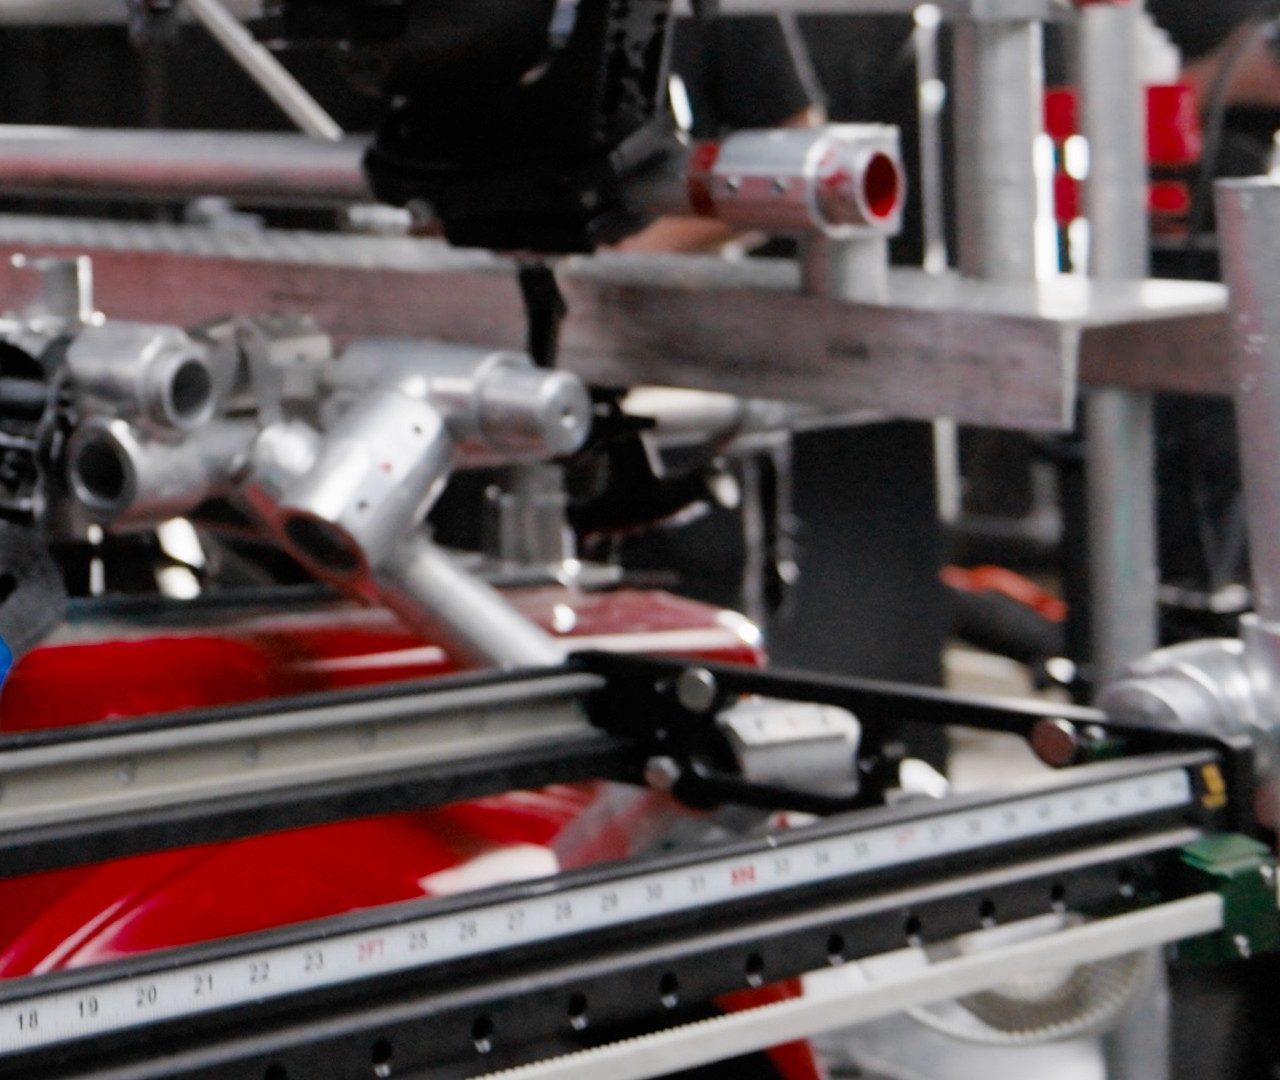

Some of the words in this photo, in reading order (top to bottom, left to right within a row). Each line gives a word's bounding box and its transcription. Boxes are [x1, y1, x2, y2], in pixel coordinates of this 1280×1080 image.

[17, 1009, 39, 1031] 18
[78, 996, 100, 1018] 19
[136, 985, 158, 1008] 20
[193, 973, 214, 996] 21
[249, 960, 270, 983] 22
[303, 948, 325, 972] 23
